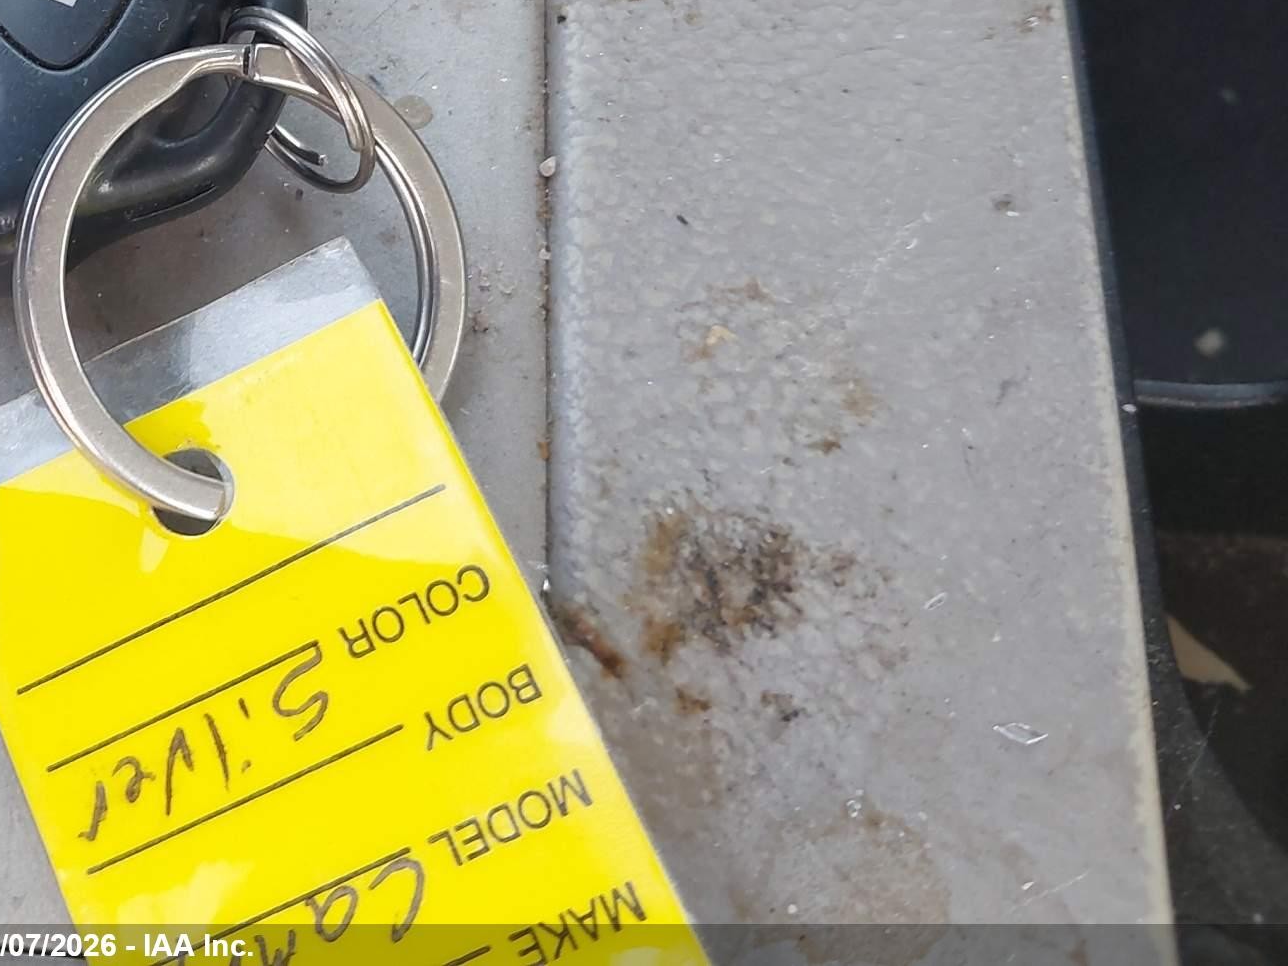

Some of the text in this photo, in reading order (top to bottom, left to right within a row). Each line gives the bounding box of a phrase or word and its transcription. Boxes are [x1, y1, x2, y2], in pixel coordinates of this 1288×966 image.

[338, 563, 491, 660] COLOR
[78, 642, 332, 842] Silver
[423, 662, 542, 751] BODY
[427, 768, 595, 868] MODEL
[507, 880, 648, 966] MAKE
